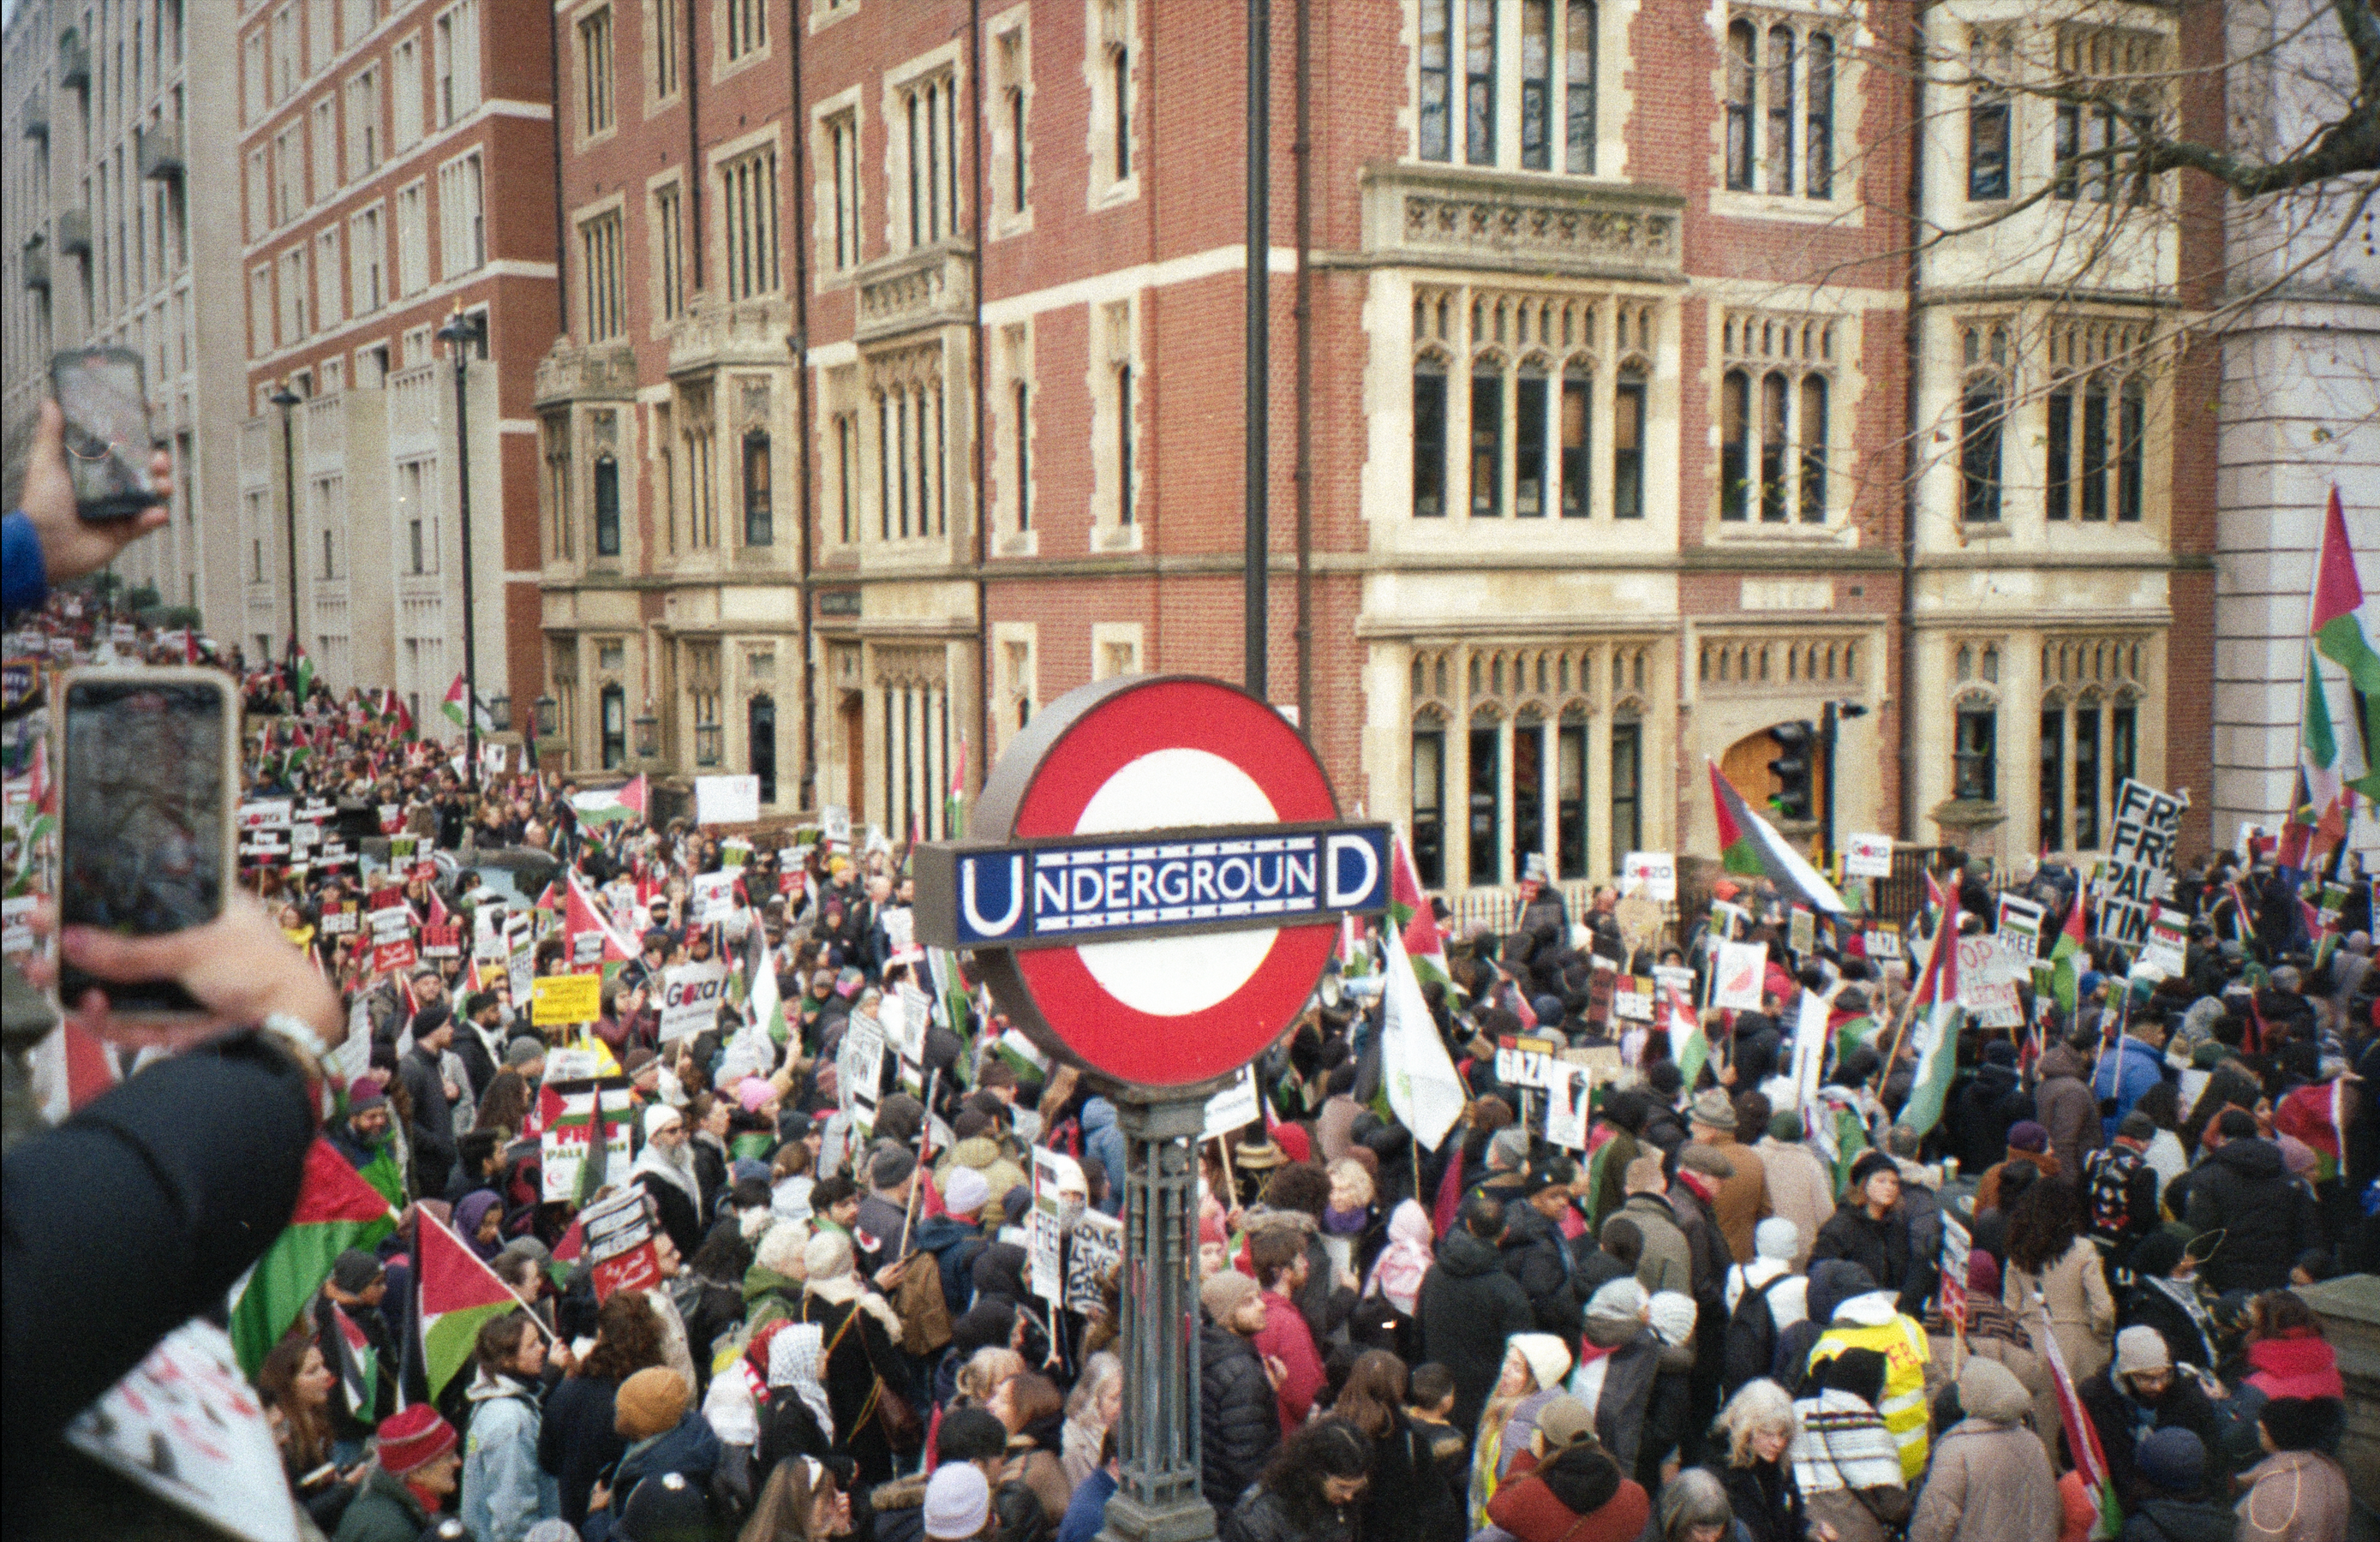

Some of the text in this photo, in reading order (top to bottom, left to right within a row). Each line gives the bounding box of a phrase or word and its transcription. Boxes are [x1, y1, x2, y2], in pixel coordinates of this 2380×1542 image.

[2120, 783, 2181, 829] FR
[2112, 819, 2174, 870] FR
[961, 835, 1378, 937] UNDERGROUND
[2100, 899, 2151, 944] TIN
[1958, 940, 1994, 969] OP
[1998, 928, 2036, 956] FREE
[1495, 1048, 1552, 1088] GAZA
[545, 1141, 627, 1161] PALENE
[557, 1121, 619, 1145] FRE
